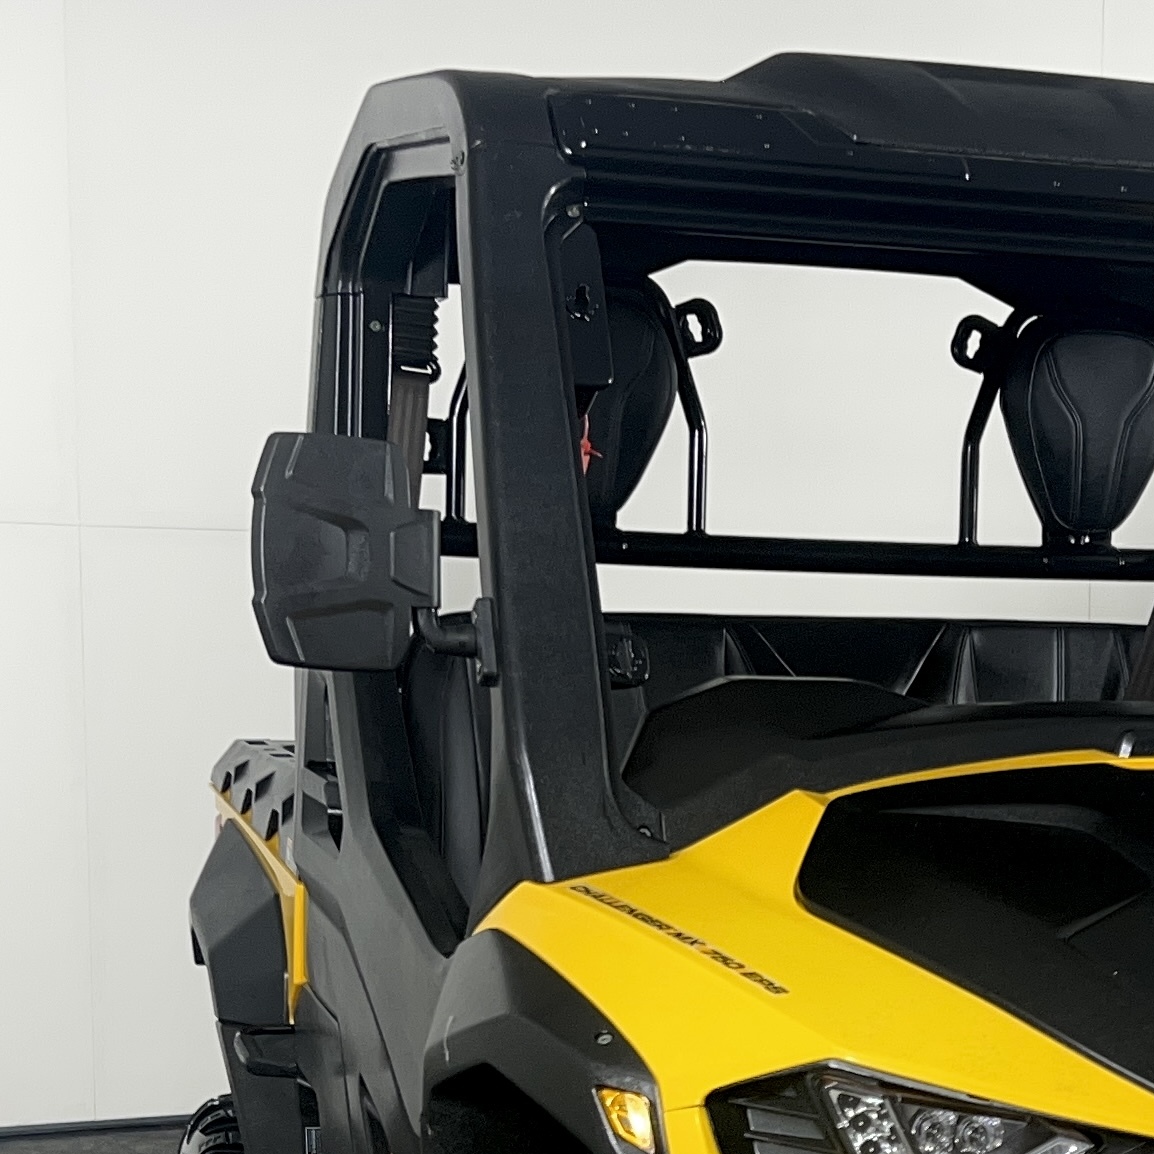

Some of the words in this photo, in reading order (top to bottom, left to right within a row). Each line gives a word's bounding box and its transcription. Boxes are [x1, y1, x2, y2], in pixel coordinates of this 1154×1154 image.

[570, 884, 675, 931] CHALLENGER
[667, 929, 705, 947] MX
[700, 948, 746, 970] 750
[739, 970, 790, 996] EPS
